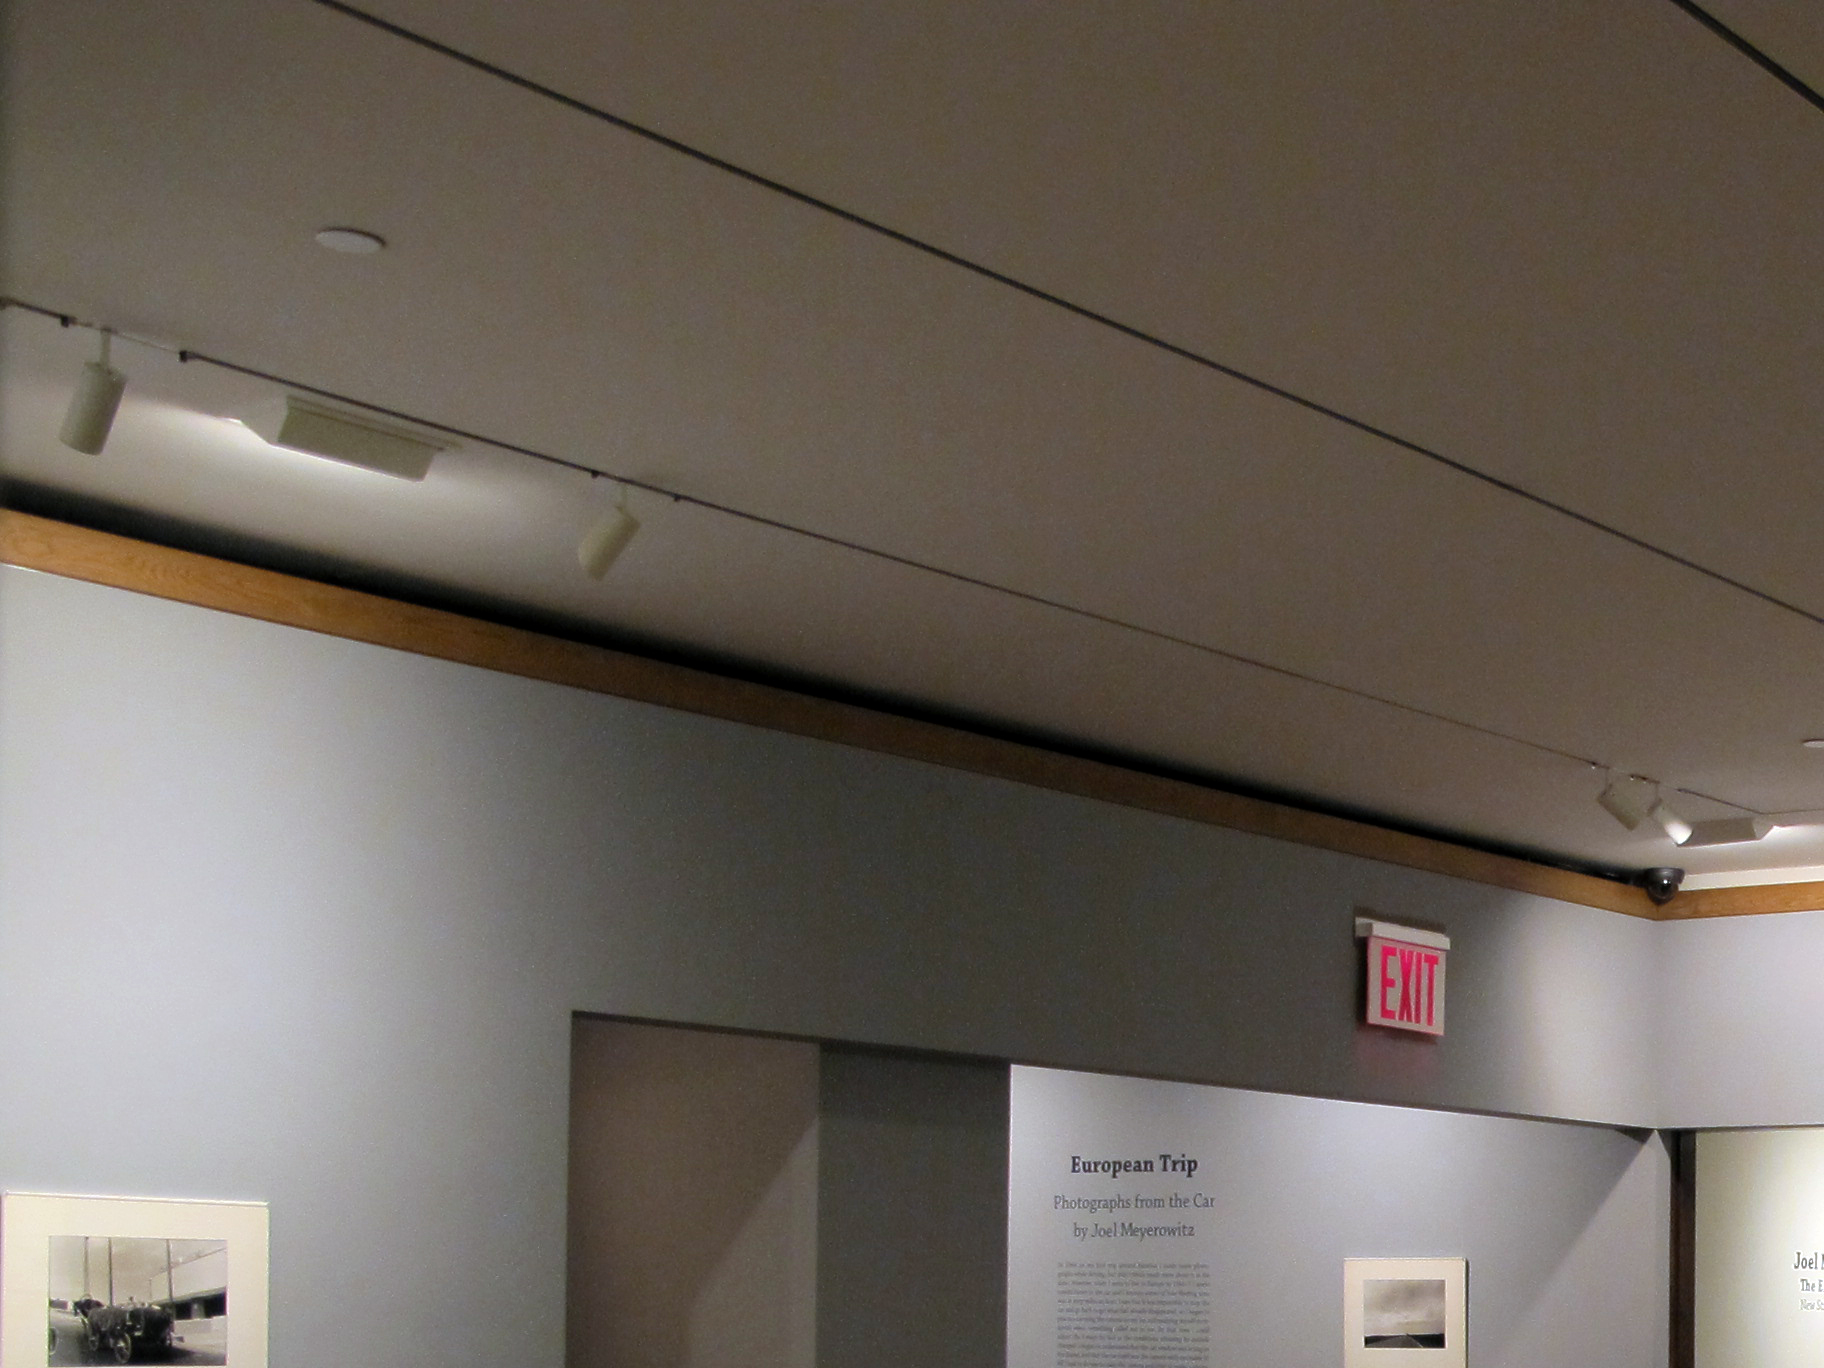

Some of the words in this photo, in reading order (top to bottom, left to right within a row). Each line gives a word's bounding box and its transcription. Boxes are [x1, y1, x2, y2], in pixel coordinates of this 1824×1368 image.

[1380, 944, 1440, 1027] EXIT
[1071, 1155, 1155, 1178] European
[1159, 1153, 1198, 1178] Trip
[1054, 1194, 1131, 1213] Photographs
[1135, 1193, 1165, 1209] from
[1169, 1192, 1190, 1208] the
[1193, 1192, 1216, 1208] Car
[1073, 1222, 1088, 1241] by
[1091, 1222, 1117, 1238] Joel
[1121, 1221, 1195, 1241] Meyerowitz
[1794, 1251, 1818, 1269] Joel
[1800, 1278, 1816, 1292] The
